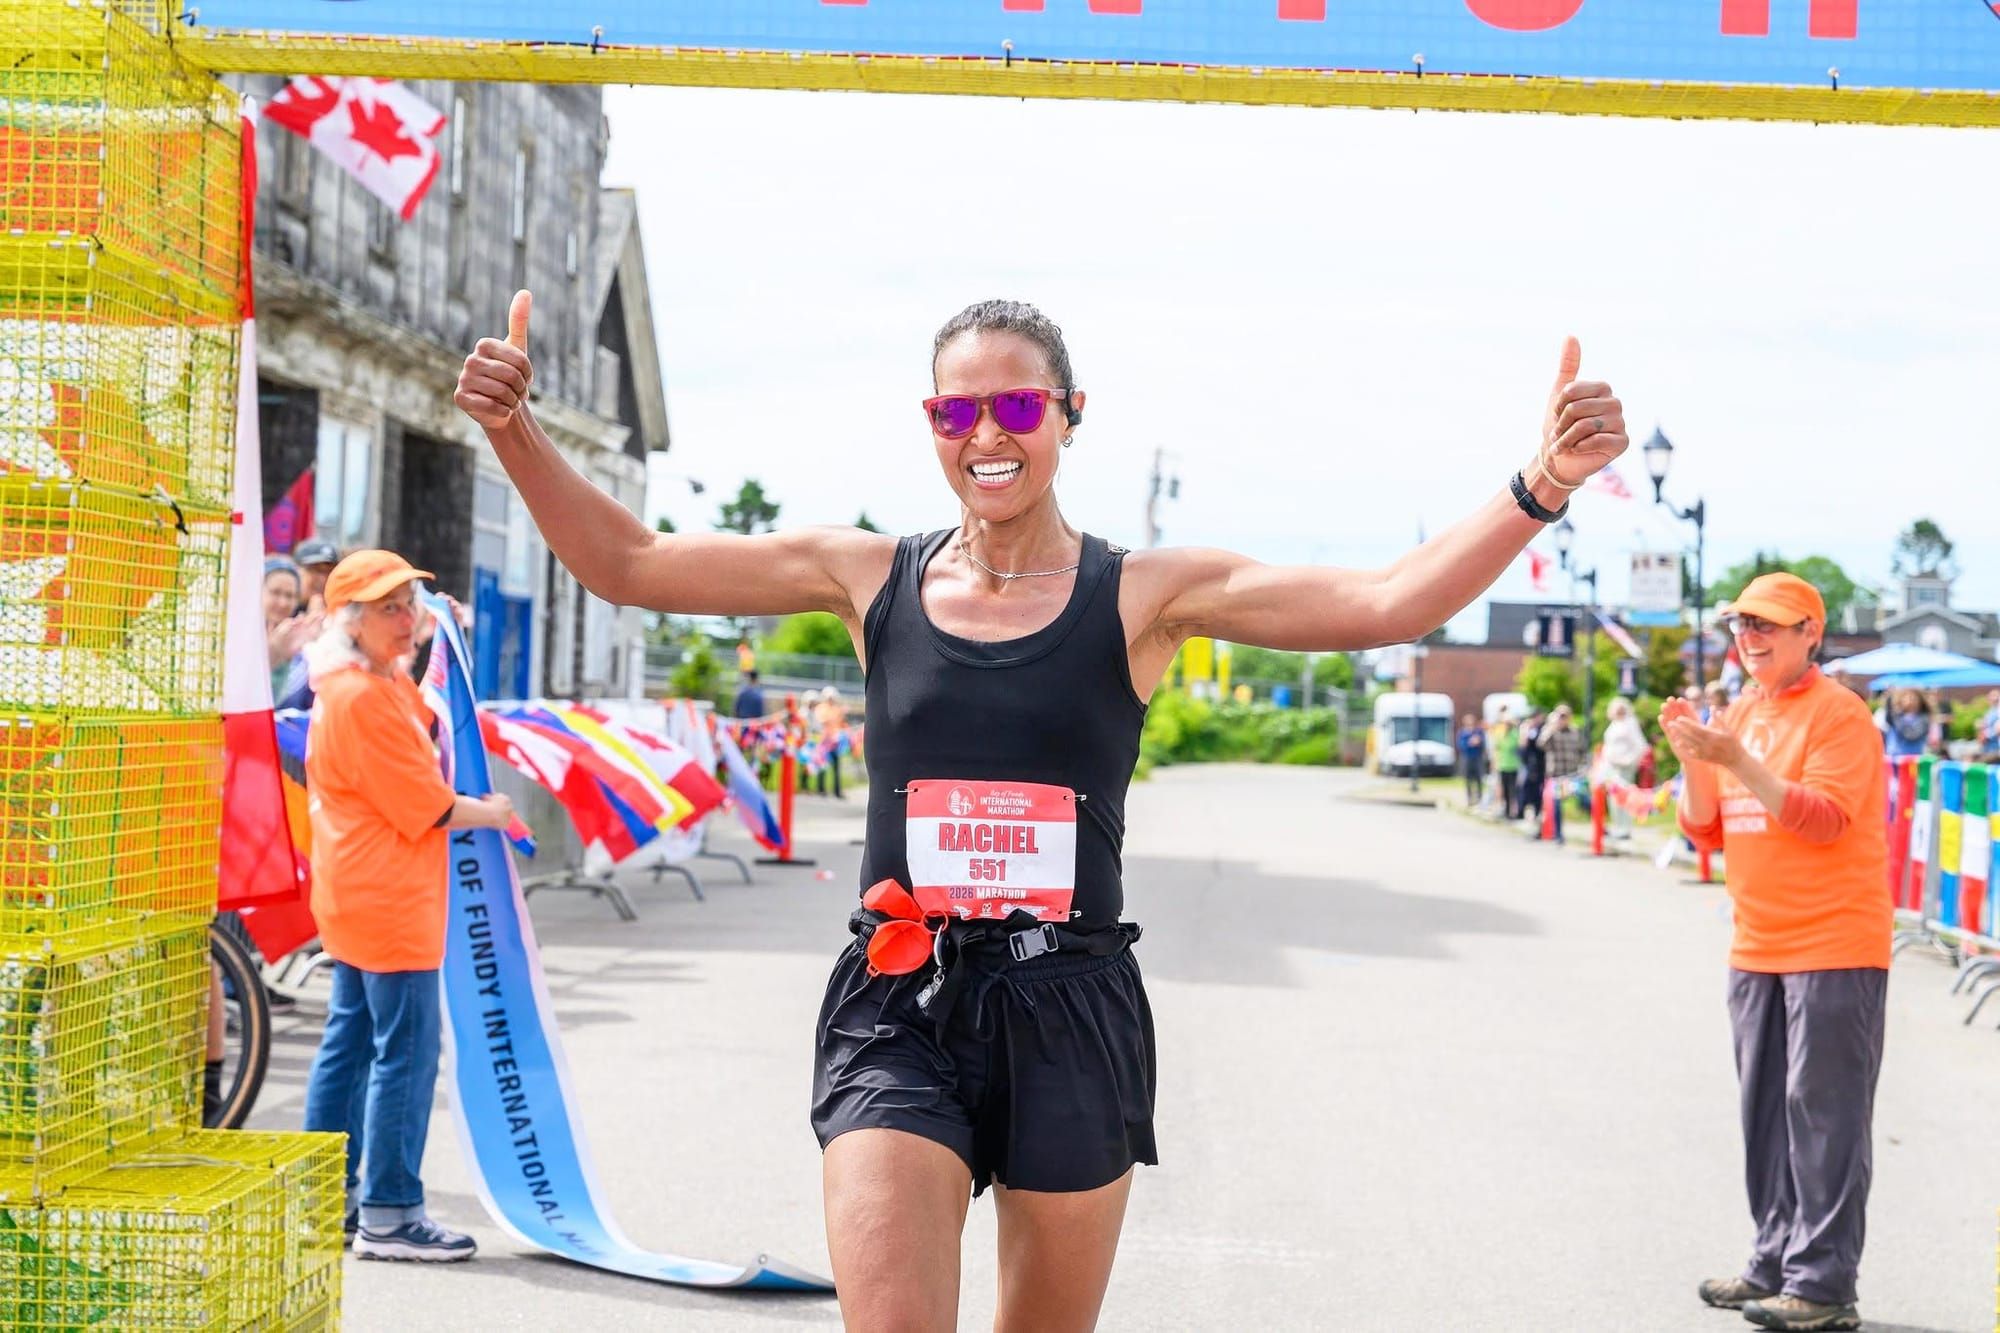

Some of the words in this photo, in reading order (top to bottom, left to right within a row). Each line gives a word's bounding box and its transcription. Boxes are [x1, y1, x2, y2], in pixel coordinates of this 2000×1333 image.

[980, 796, 1032, 807] INTERNATIONAL
[987, 806, 1025, 816] MARATHON
[938, 823, 1039, 854] RACHEL
[457, 857, 483, 894] OF
[969, 858, 1006, 881] 551
[949, 887, 974, 899] 2026
[976, 887, 1026, 899] MARATHON
[464, 903, 502, 998] FUNDY
[482, 1009, 564, 1226] INTERNATIONAL
